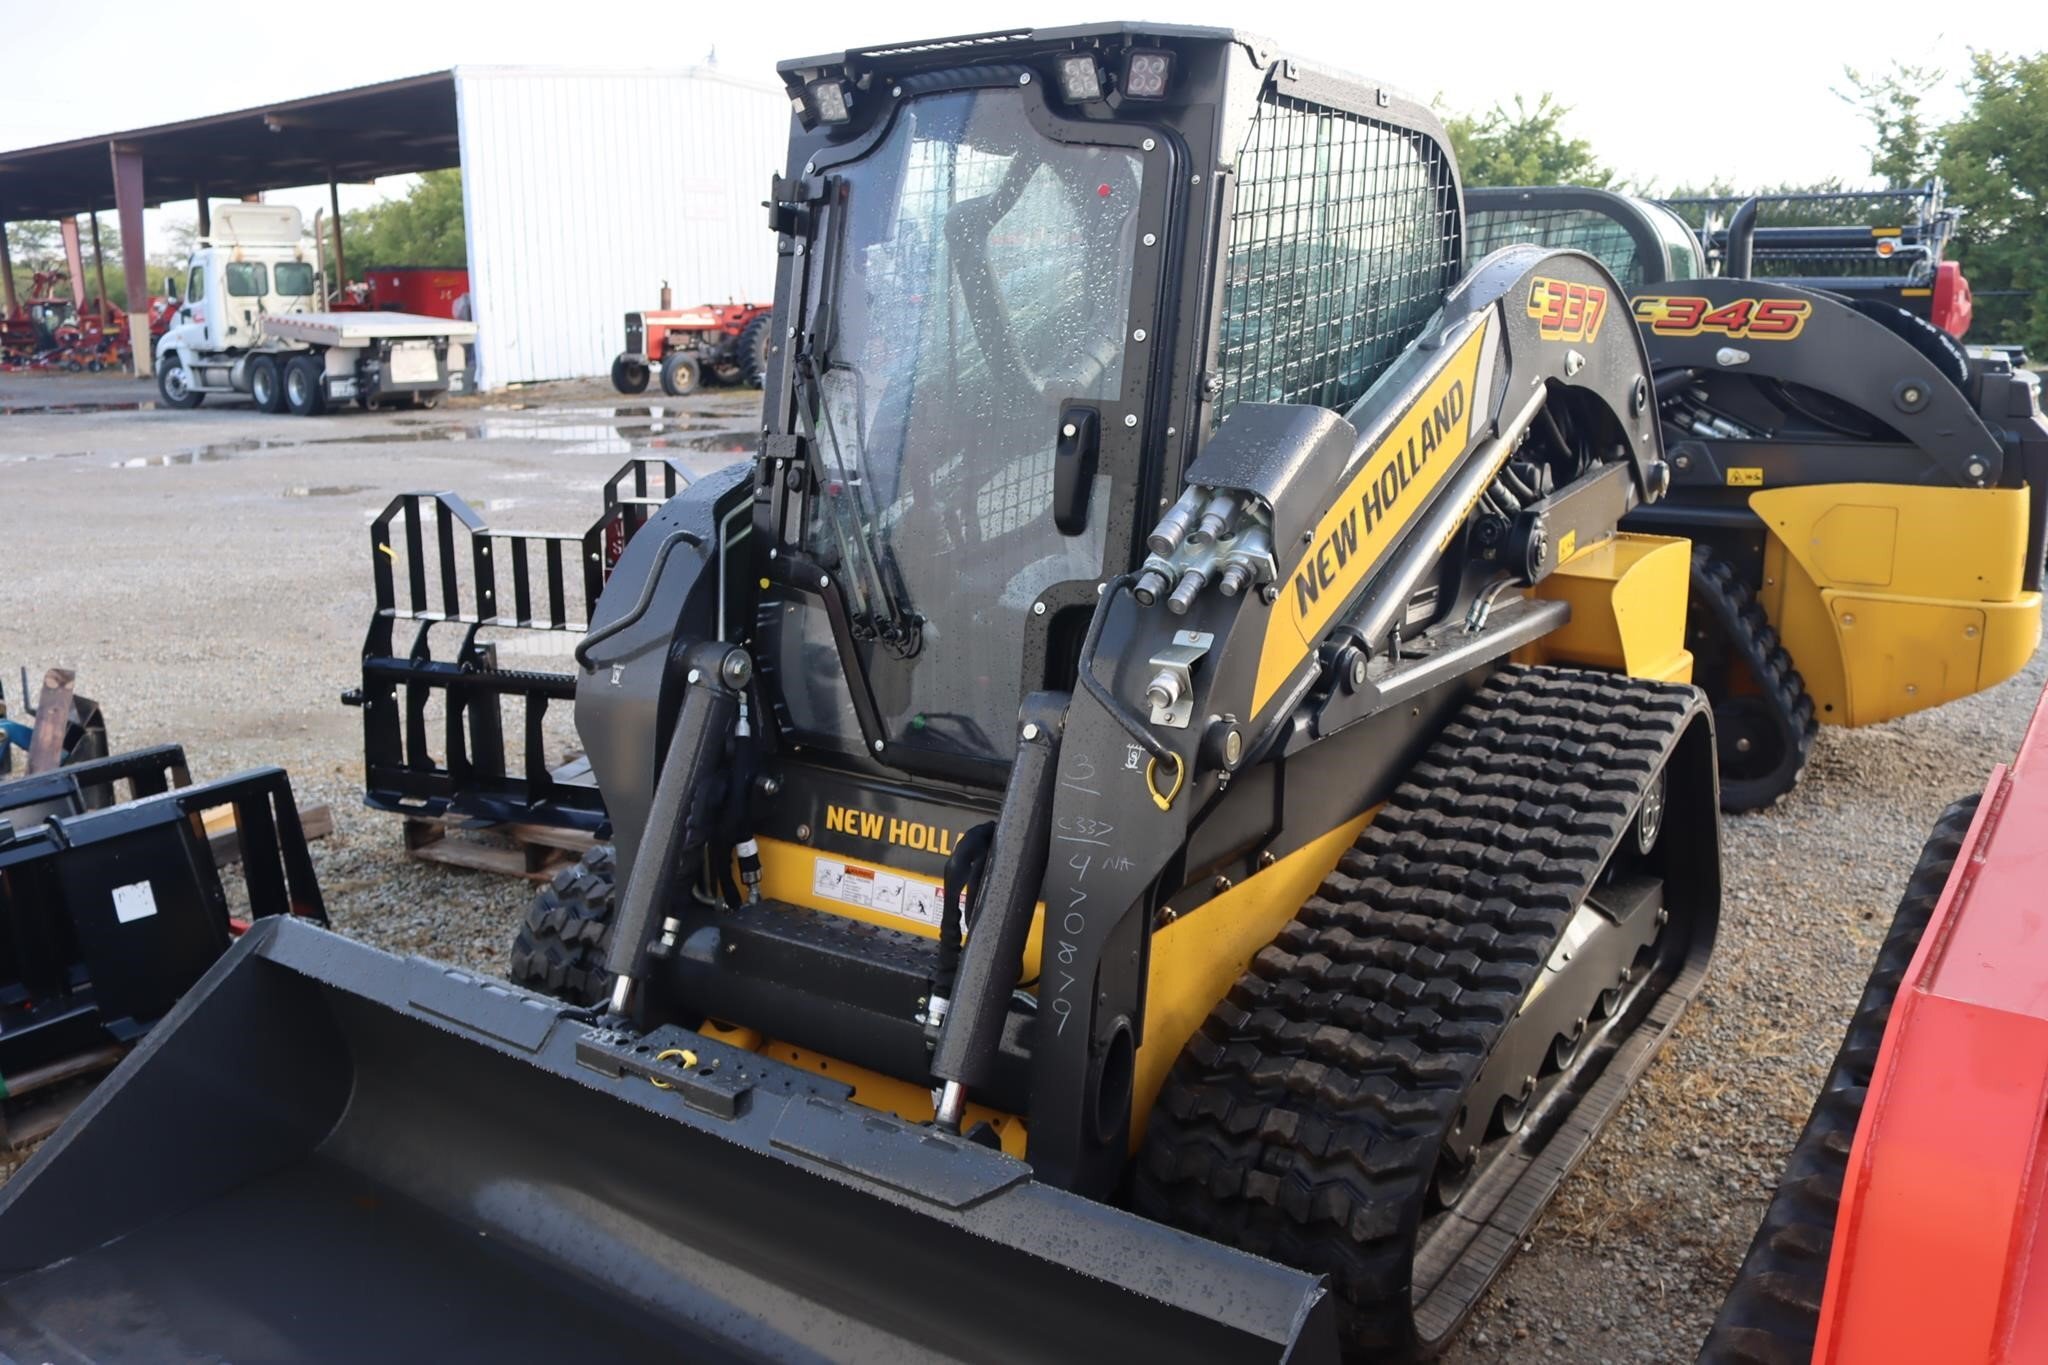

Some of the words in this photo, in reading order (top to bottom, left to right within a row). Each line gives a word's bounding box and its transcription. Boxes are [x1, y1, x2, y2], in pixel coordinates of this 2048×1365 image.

[1530, 279, 1606, 339] C337
[1633, 298, 1809, 336] C345
[1295, 507, 1358, 619] NEW
[1362, 379, 1465, 537] HOLLAND
[826, 805, 884, 840] NEW
[888, 818, 964, 857] HOLL
